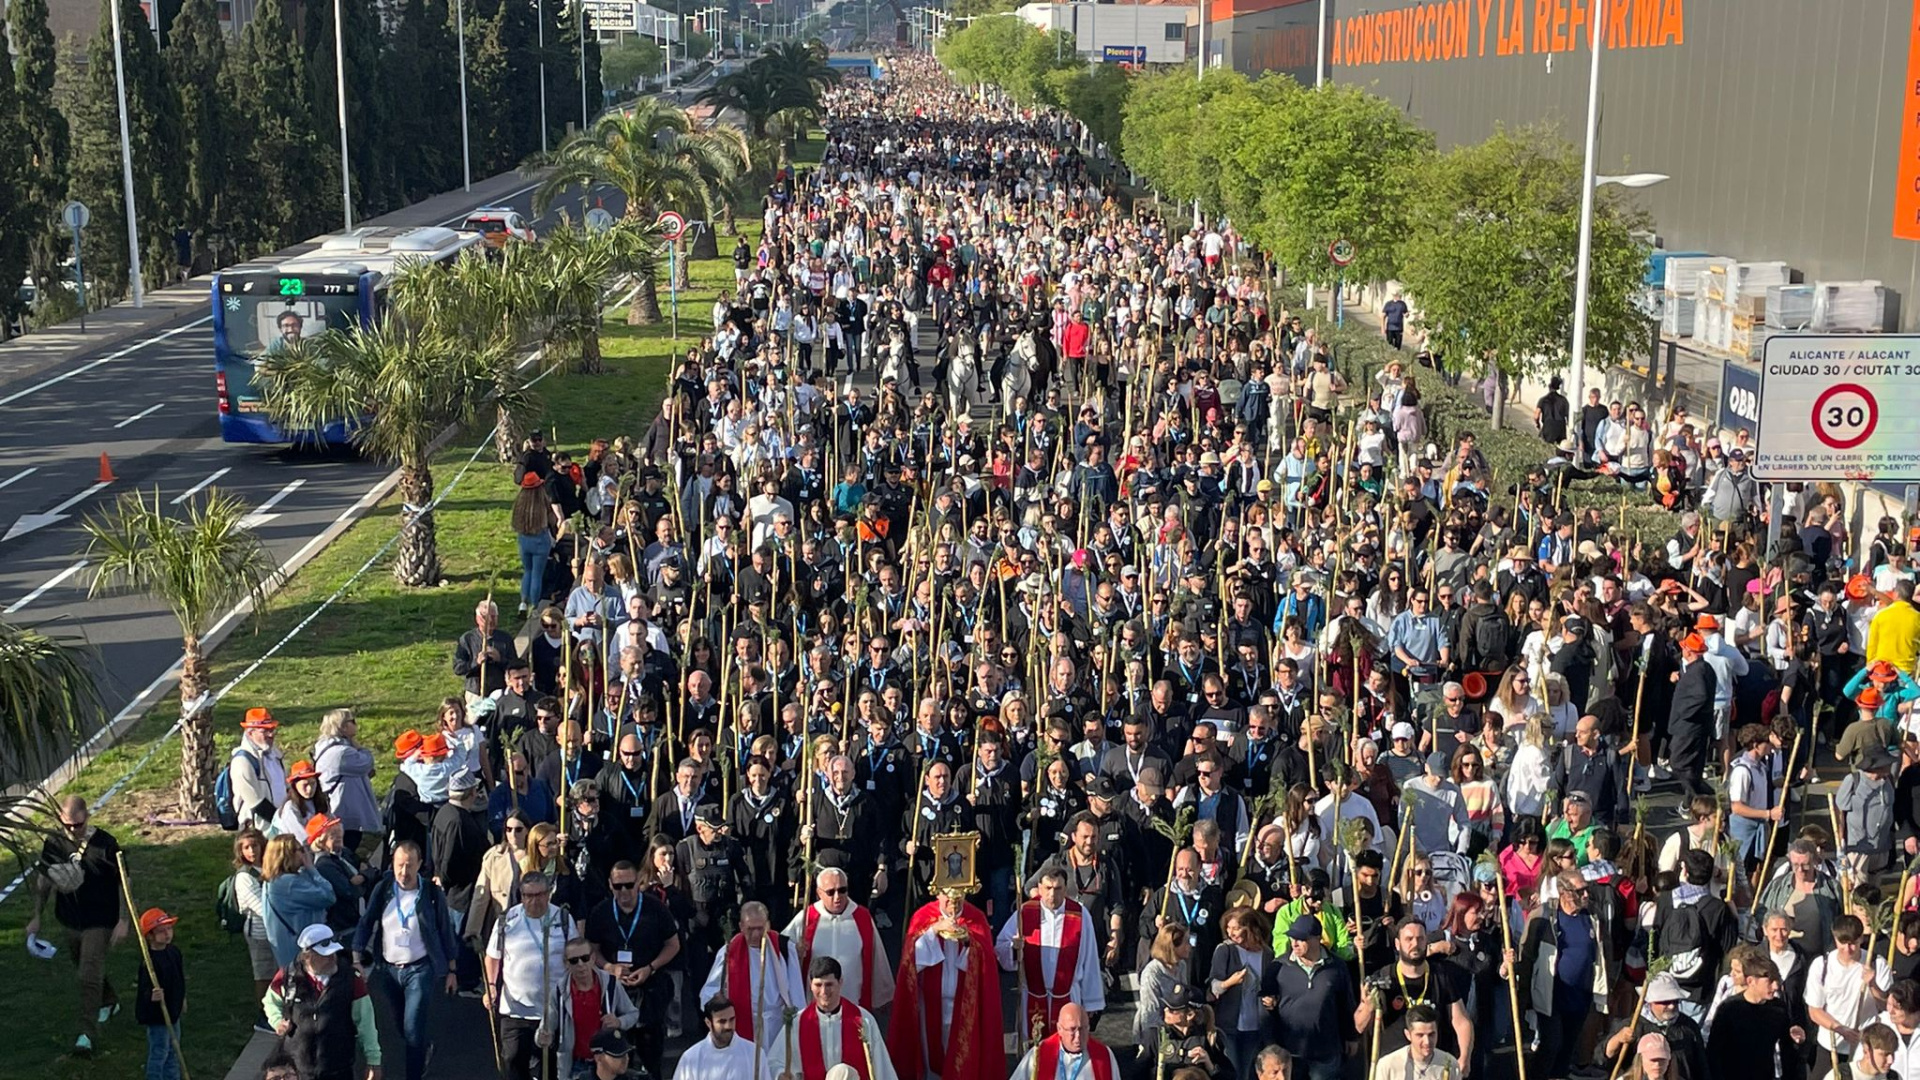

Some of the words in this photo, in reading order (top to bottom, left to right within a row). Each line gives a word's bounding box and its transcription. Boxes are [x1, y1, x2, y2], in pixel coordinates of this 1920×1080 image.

[1477, 0, 1492, 57] Y
[1497, 0, 1524, 56] LA
[1533, 0, 1684, 53] REFORMA
[279, 278, 303, 295] 23
[323, 284, 341, 293] 777
[1789, 350, 1845, 360] ALICANTE
[1857, 350, 1911, 360] ALACANT
[1769, 364, 1819, 376] CIUDAD
[1823, 364, 1840, 376] 30
[1853, 365, 1901, 376] CIUTAT
[1904, 365, 1920, 376] 30
[1827, 407, 1864, 427] 30
[1760, 454, 1771, 462] EN
[1774, 454, 1803, 462] CALLES
[1807, 454, 1818, 462] DE
[1820, 454, 1833, 462] UN
[1836, 454, 1863, 462] CARRIL
[1867, 454, 1883, 462] POR
